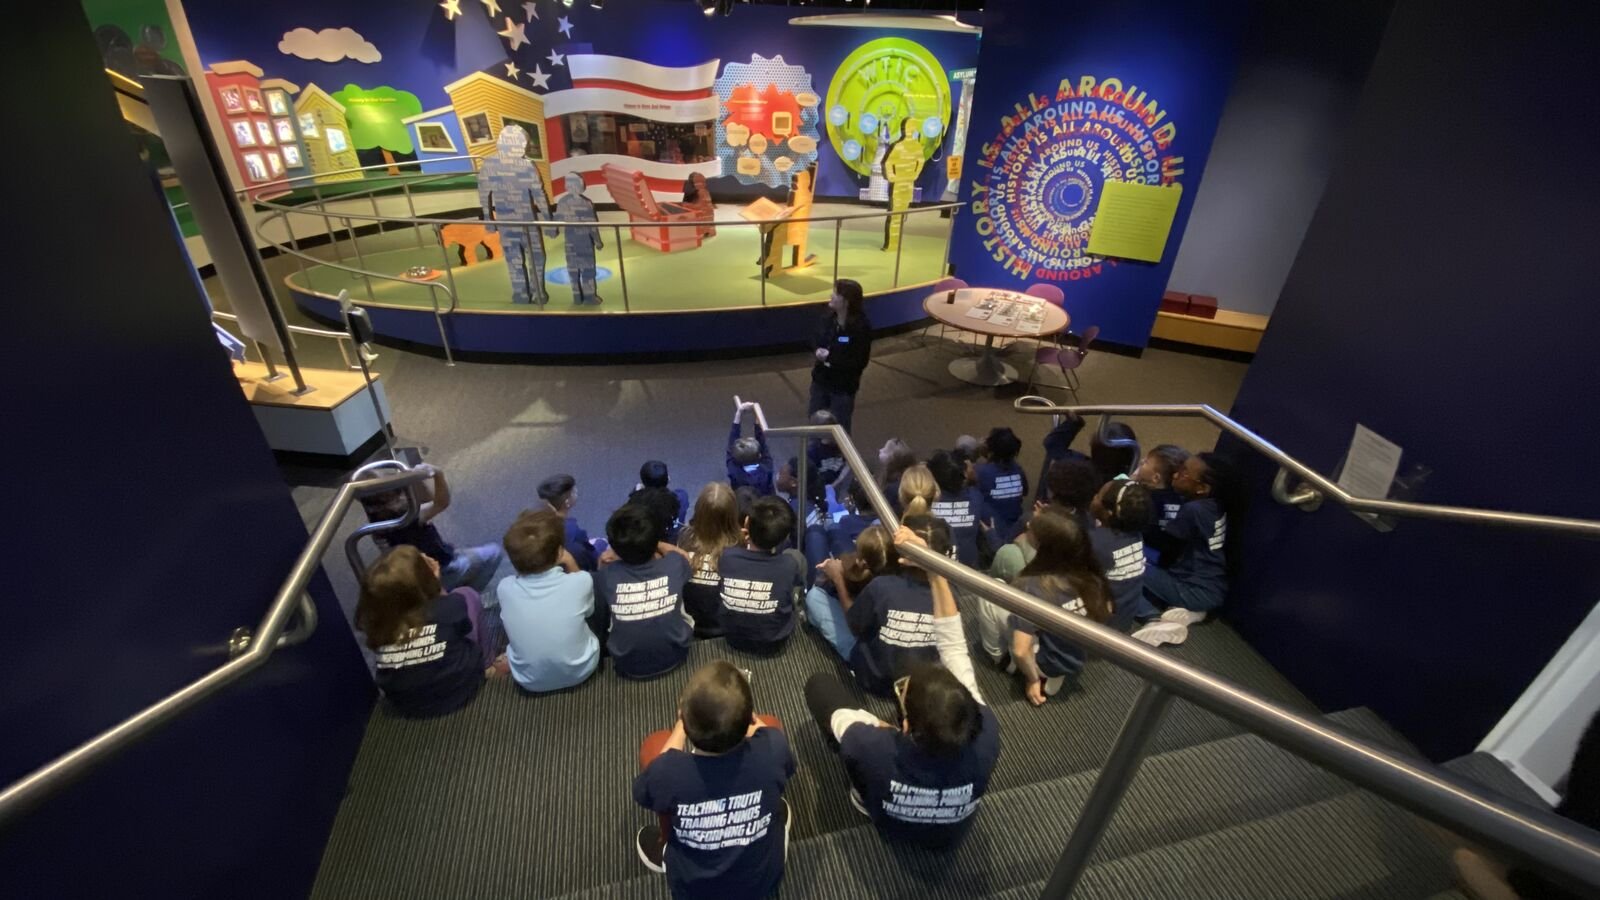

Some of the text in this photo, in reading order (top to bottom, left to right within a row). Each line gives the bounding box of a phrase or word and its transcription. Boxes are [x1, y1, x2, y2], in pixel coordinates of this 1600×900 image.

[858, 56, 920, 83] WTIC
[1023, 100, 1097, 134] AROUND
[1056, 75, 1177, 144] AROUND
[977, 142, 998, 168] IS
[1006, 145, 1033, 203] HISTORY
[971, 181, 1032, 281] HISTORY
[1035, 263, 1103, 281] AROUND
[646, 575, 669, 590] TRUTH
[660, 593, 678, 608] LIVES
[760, 599, 779, 609] LIVES
[423, 641, 448, 656] LIVES
[677, 789, 763, 816] TEACHING TRUTH
[882, 799, 958, 818] TRANSFORMING
[680, 804, 761, 829] TRAINING MINDS
[745, 812, 772, 836] LIVES
